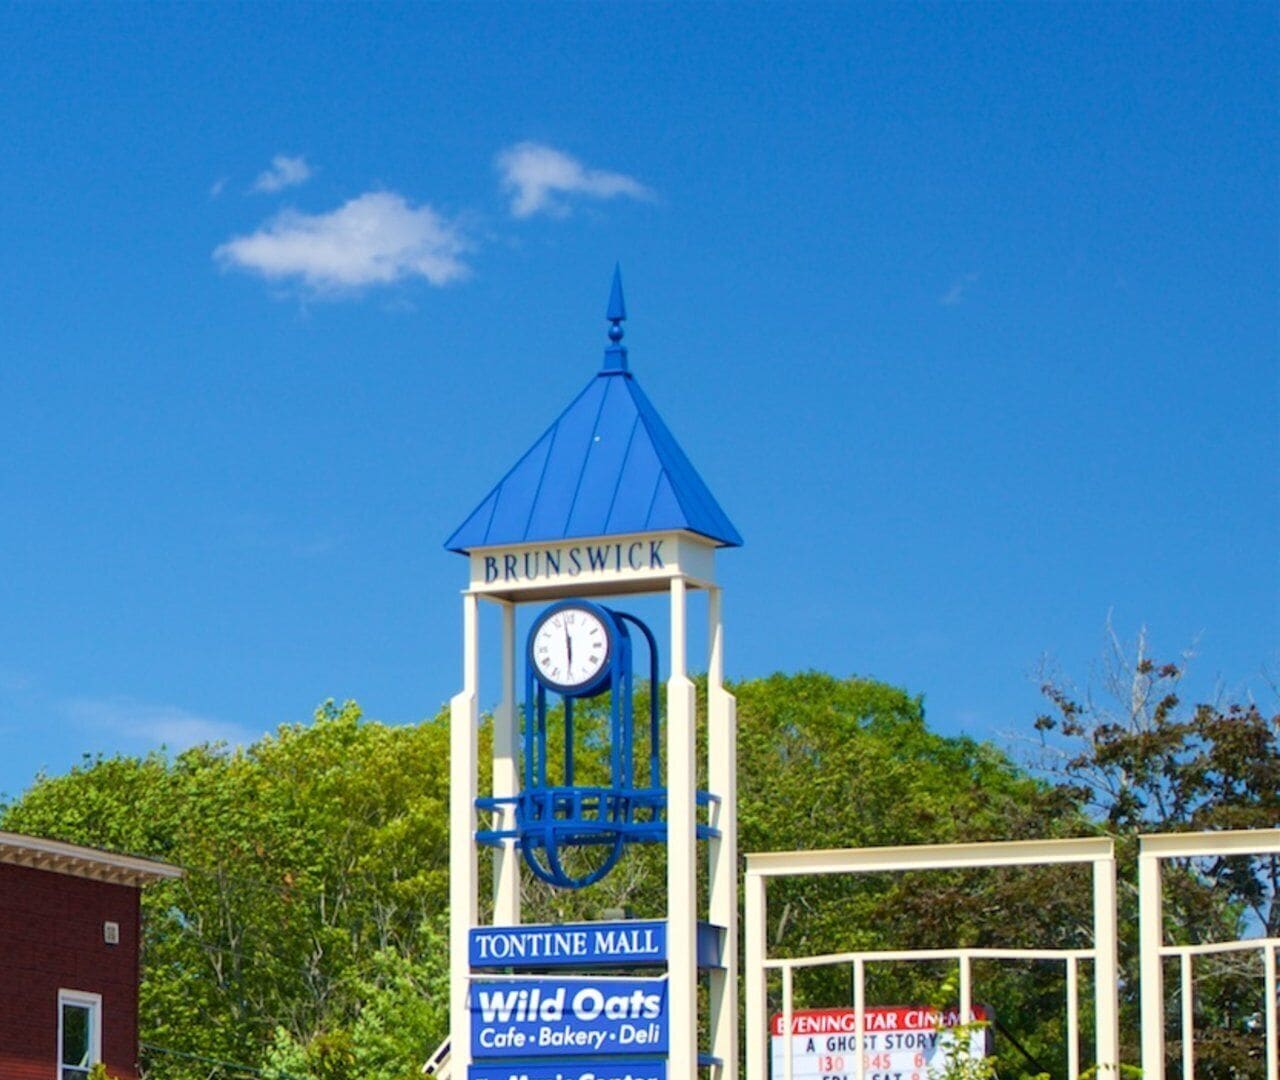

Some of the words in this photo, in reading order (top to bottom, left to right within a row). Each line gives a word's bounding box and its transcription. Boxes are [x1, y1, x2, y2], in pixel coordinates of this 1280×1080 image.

[484, 540, 666, 584] BRUNSWICK
[476, 933, 587, 958] TONTINE
[594, 930, 658, 954] MALL
[479, 988, 566, 1023] Wild
[572, 988, 661, 1021] Oats
[480, 1027, 526, 1048] Cafe
[539, 1026, 607, 1050] Bakery
[620, 1024, 660, 1044] Deli
[806, 1038, 815, 1052] A
[885, 1033, 938, 1050] STORY
